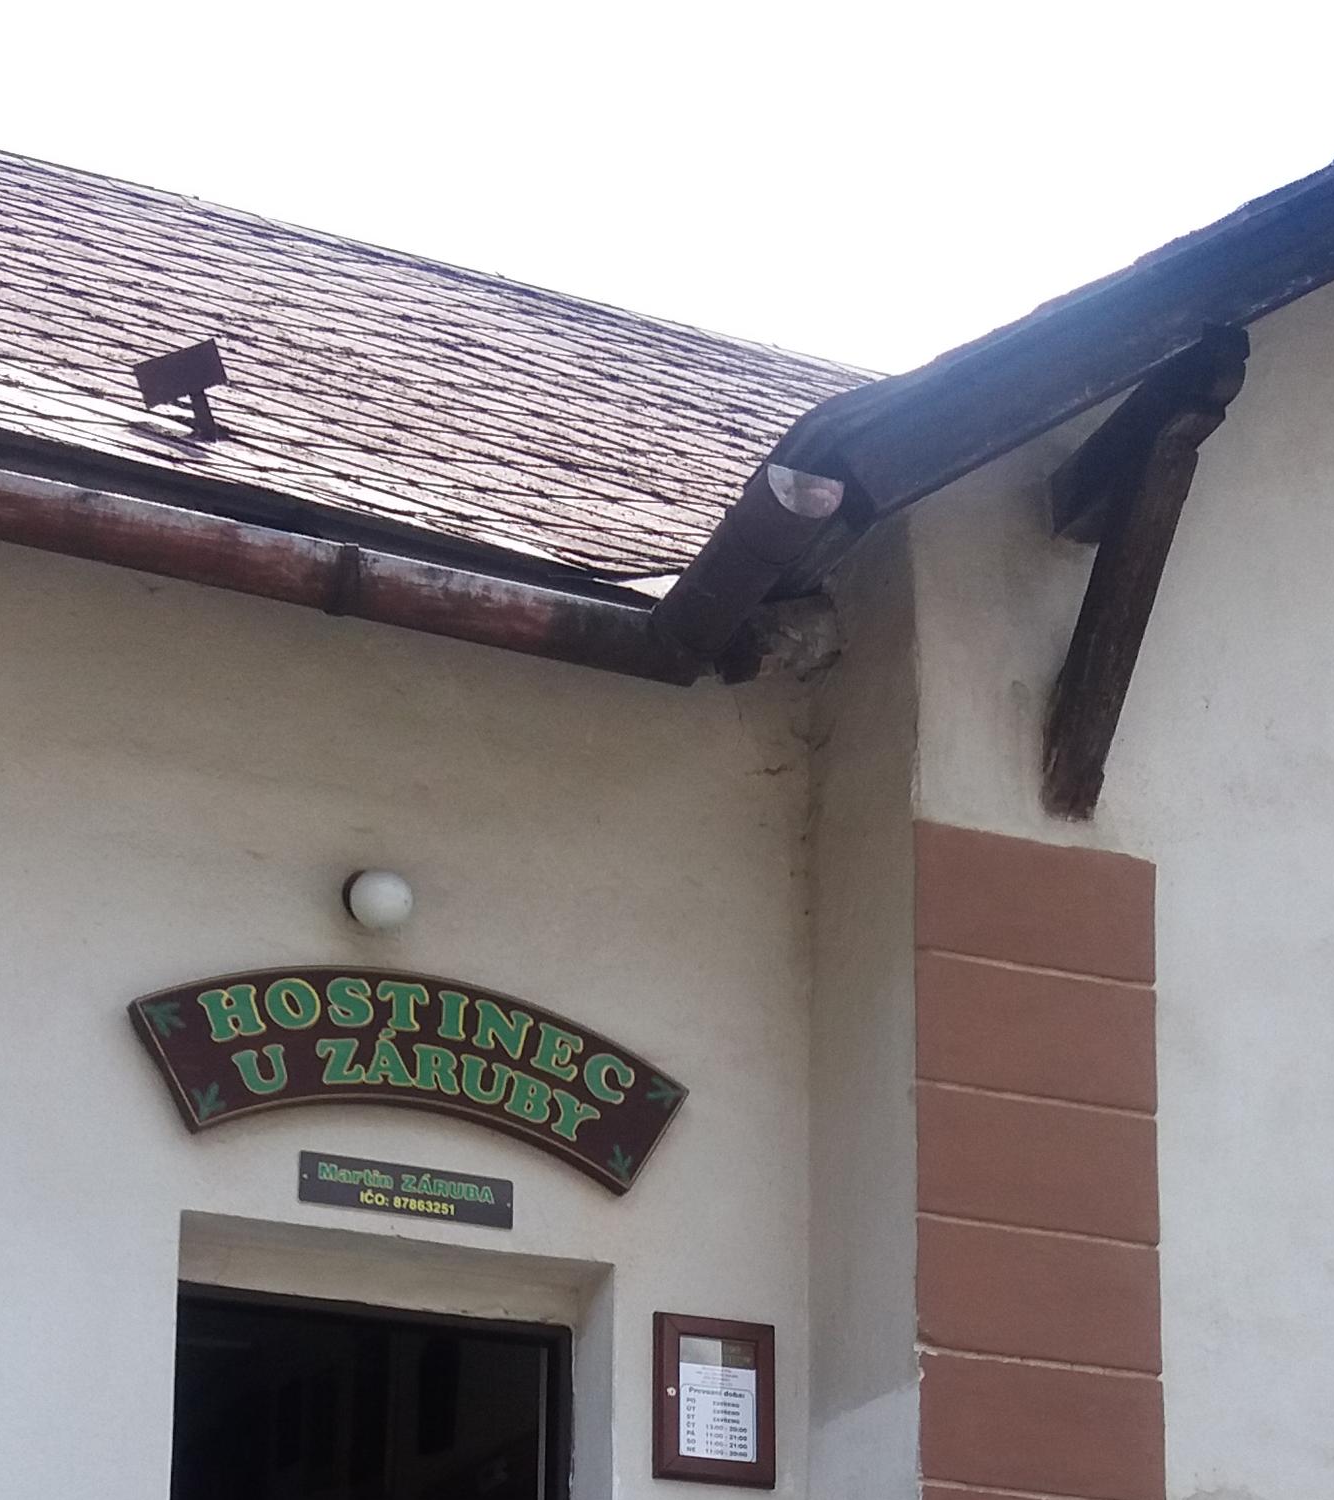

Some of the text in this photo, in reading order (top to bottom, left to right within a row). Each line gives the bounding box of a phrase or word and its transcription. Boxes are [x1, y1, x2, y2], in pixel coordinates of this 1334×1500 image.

[197, 977, 635, 1104] HOSTINEC
[232, 1029, 601, 1142] U ZÁRUBY
[318, 1162, 495, 1204] Martin ZÁRUBA
[360, 1188, 389, 1208] IČO:
